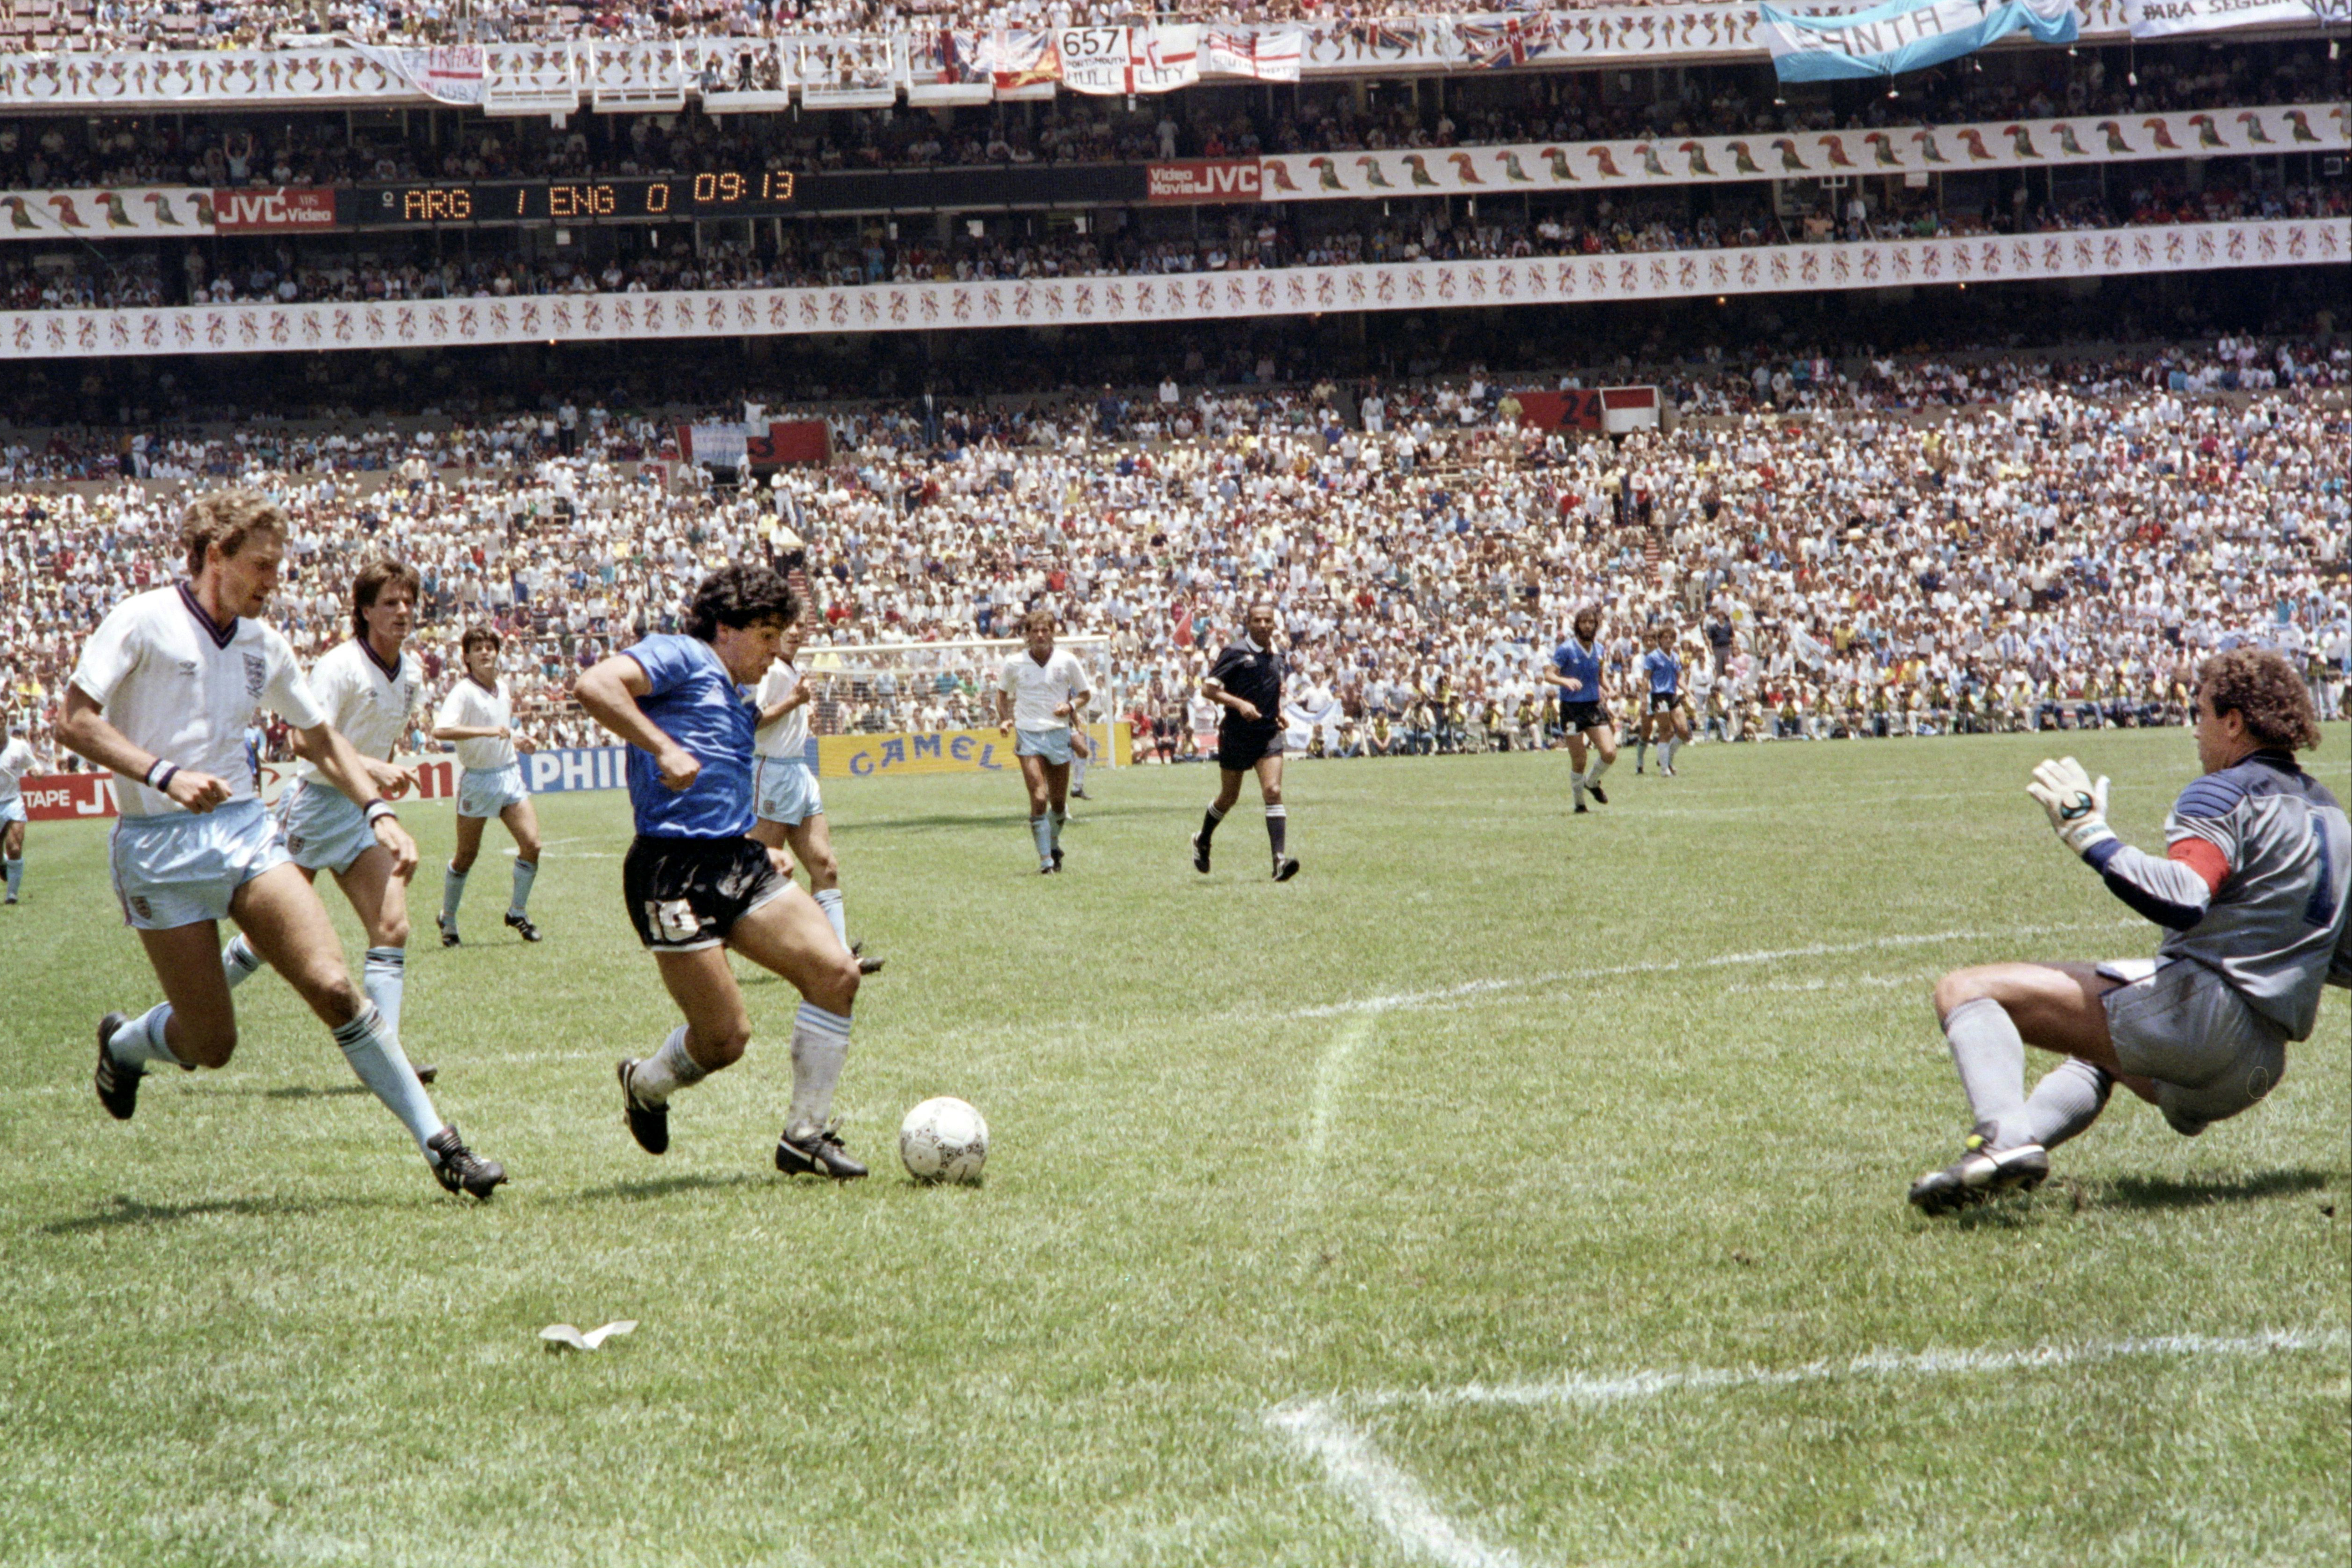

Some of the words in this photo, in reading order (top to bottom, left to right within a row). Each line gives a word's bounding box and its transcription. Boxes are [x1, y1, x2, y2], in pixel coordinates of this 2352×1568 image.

[2209, 0, 2290, 14] SEG
[1063, 28, 1119, 56] 657
[1066, 56, 1126, 68] PORTSMOUTH
[1067, 70, 1120, 85] HULL
[1150, 168, 1193, 181] Video
[1194, 165, 1258, 193] JVC
[1150, 180, 1194, 195] Movie
[218, 195, 287, 224] JVC
[405, 189, 471, 219] ARG
[518, 189, 525, 214] 1
[550, 186, 615, 215] ENG
[647, 183, 669, 211] 0
[287, 208, 331, 222] Video
[1561, 392, 1601, 425] 24
[849, 734, 1002, 776] CAMEL
[23, 789, 70, 808] TAPE
[2303, 814, 2335, 928] 1
